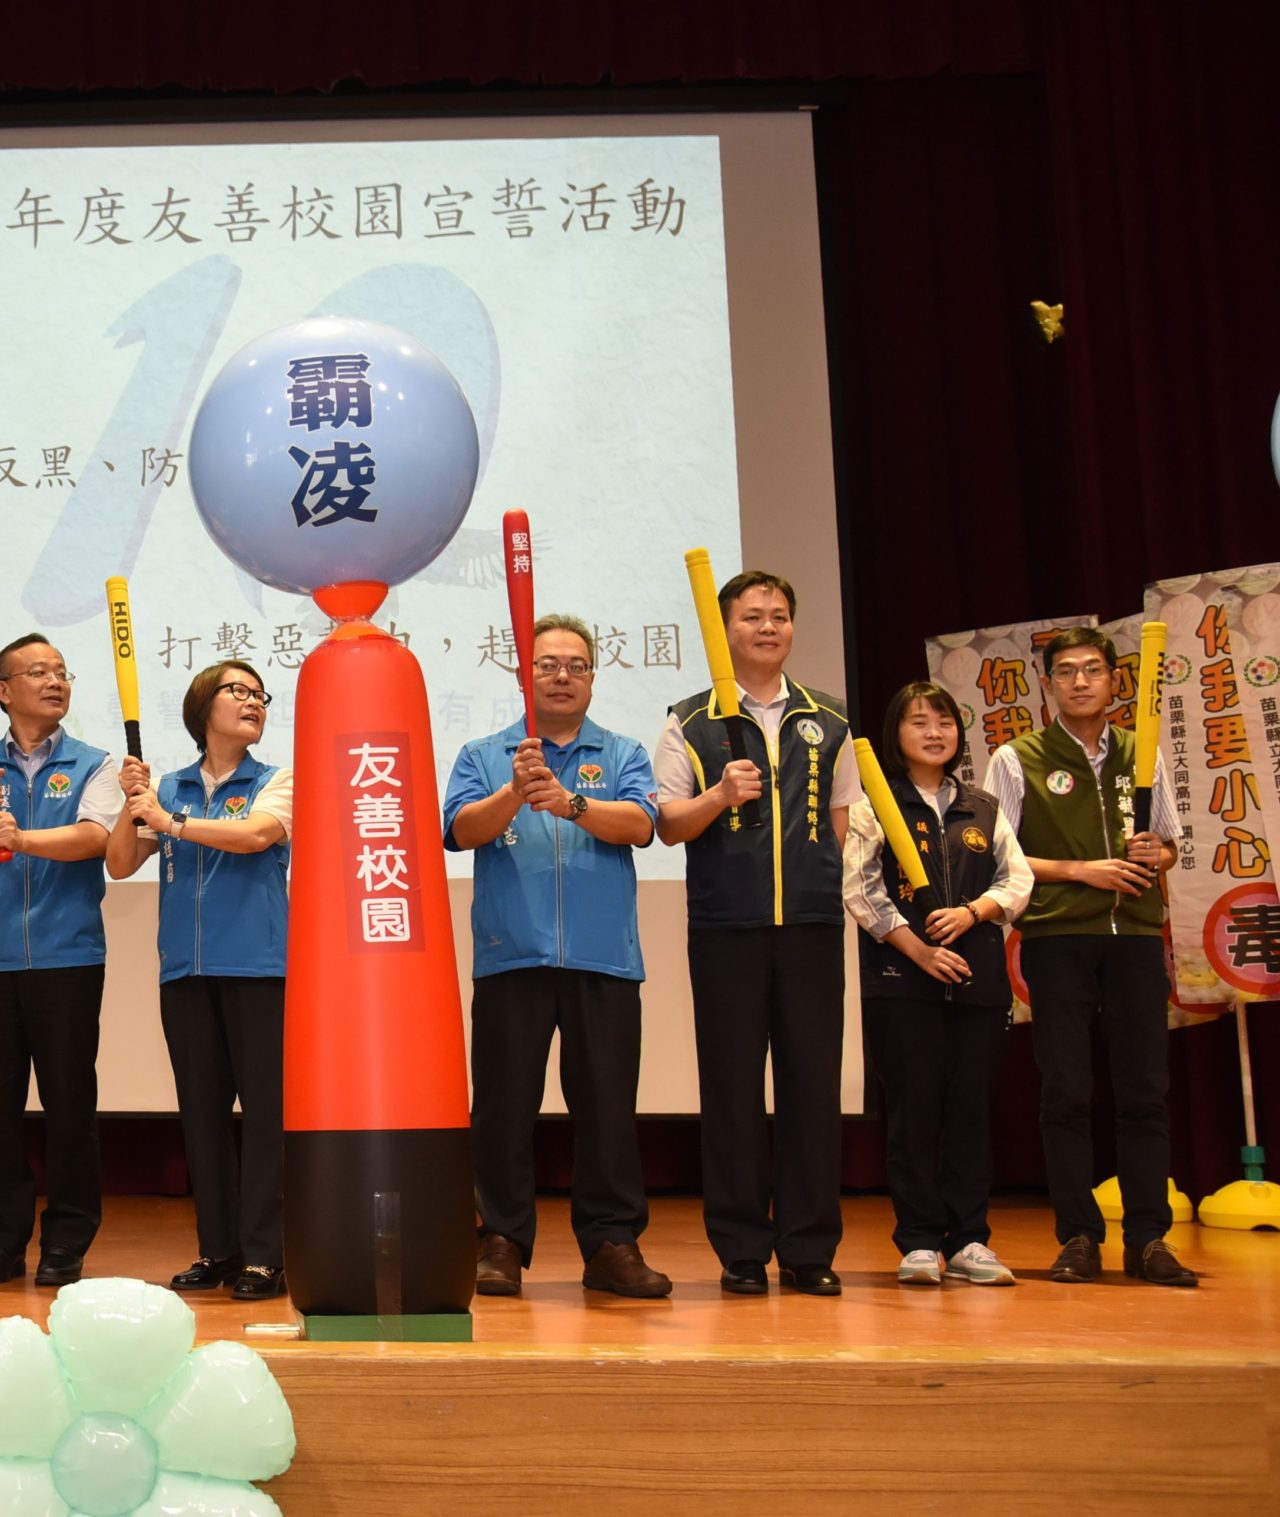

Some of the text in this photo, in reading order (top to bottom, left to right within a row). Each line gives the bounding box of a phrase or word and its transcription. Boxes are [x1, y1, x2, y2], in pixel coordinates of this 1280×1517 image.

[287, 353, 378, 528] 霸凌
[512, 532, 531, 574] 堅持
[114, 602, 131, 658] HIDO
[1167, 694, 1191, 816] 苗栗縣立大同高中
[348, 742, 412, 944] 友善校園
